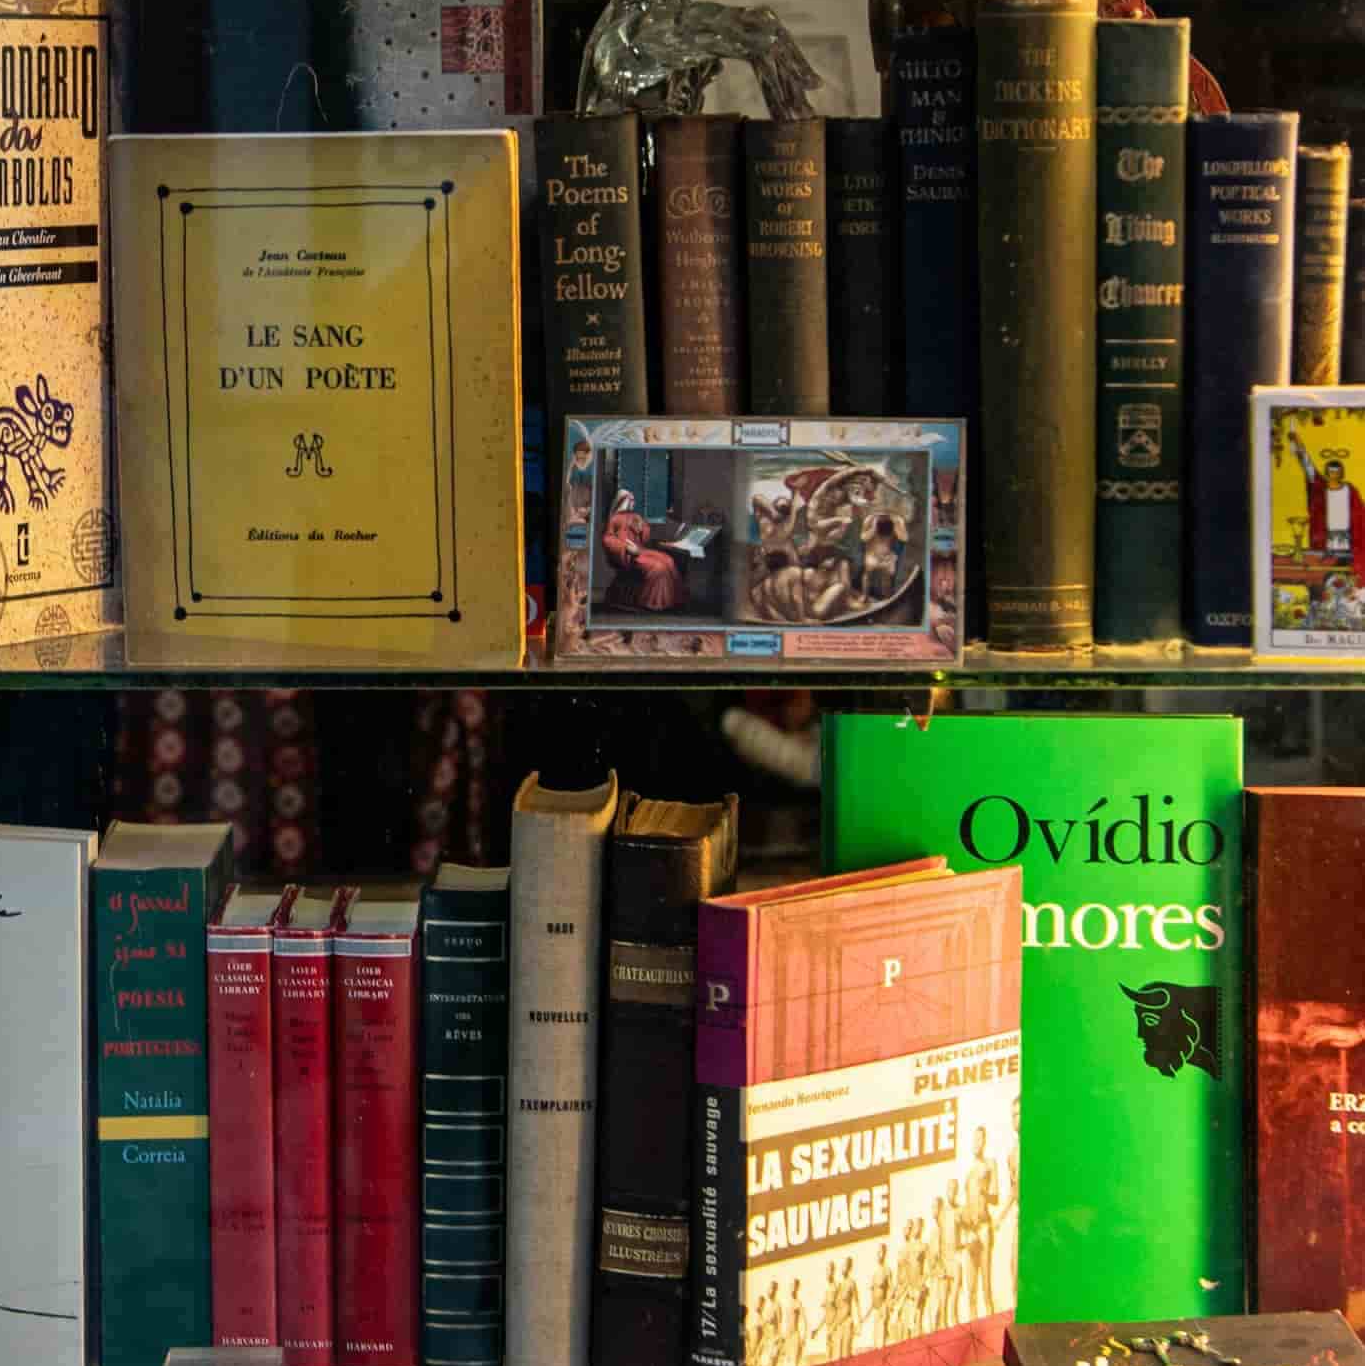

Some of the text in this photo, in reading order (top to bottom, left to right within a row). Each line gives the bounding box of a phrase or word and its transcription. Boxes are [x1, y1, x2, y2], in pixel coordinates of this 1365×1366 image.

[563, 154, 610, 179] The
[546, 178, 630, 206] Poems
[576, 211, 603, 237] of
[553, 236, 628, 275] Long-
[553, 274, 630, 302] fellow
[246, 323, 366, 349] LE SANG
[217, 361, 397, 392] D'UN POÈTE
[958, 792, 1226, 868] Ovídio
[882, 958, 902, 989] P
[708, 984, 732, 1011] P
[122, 1090, 185, 1110] Natália
[122, 1144, 187, 1165] Correia
[748, 1099, 956, 1196] LA SEXUALITÉ
[747, 1184, 890, 1259] SAUVAGE
